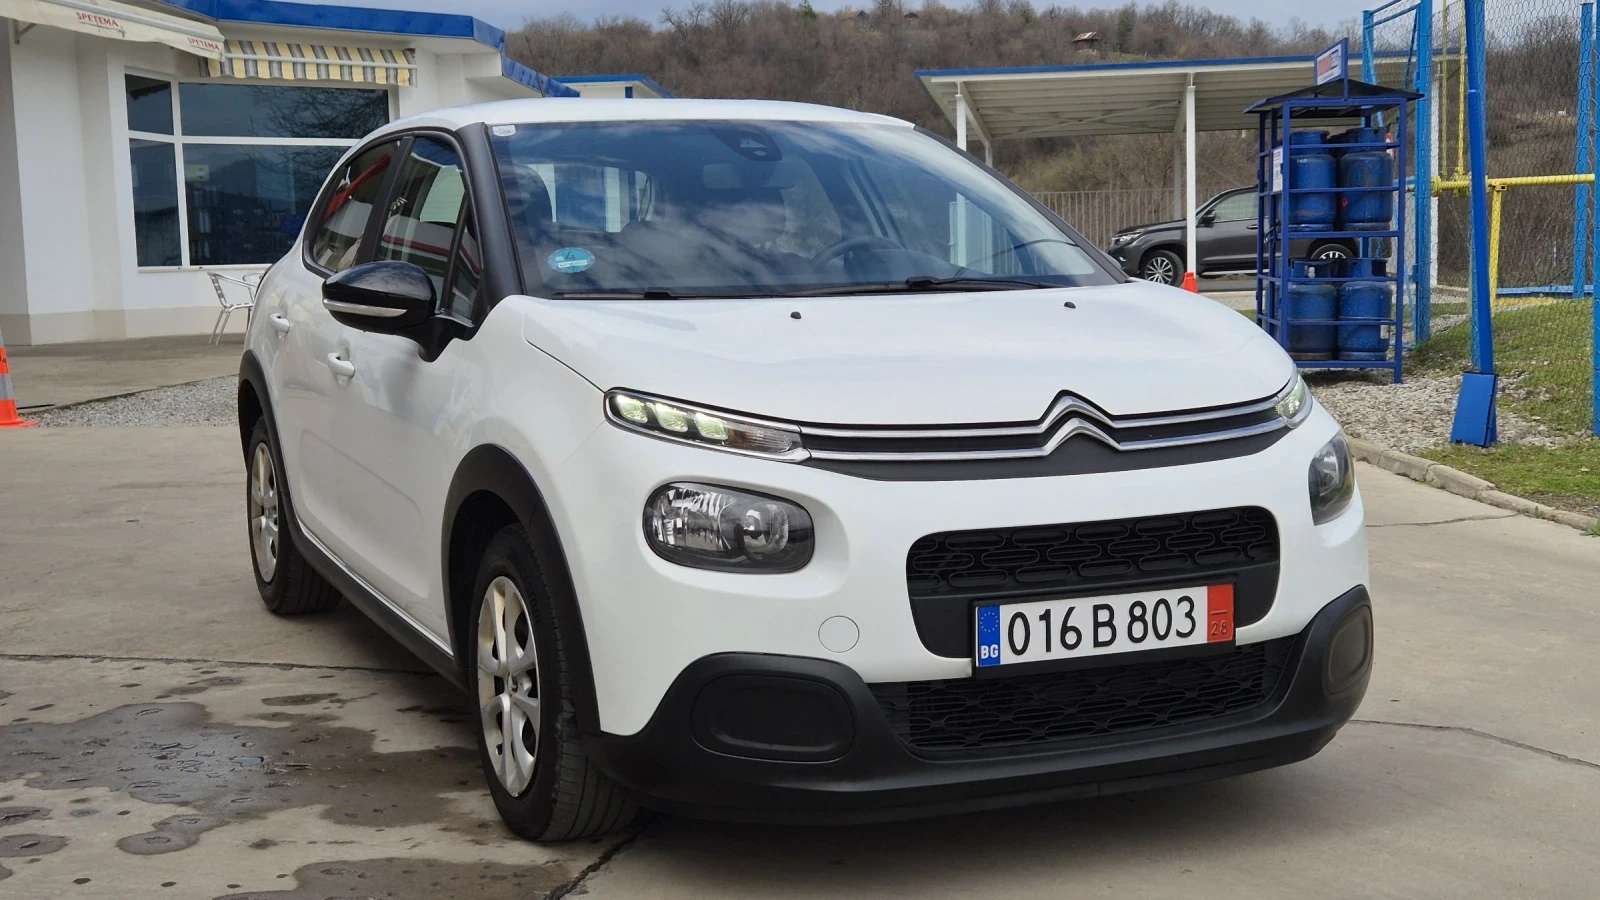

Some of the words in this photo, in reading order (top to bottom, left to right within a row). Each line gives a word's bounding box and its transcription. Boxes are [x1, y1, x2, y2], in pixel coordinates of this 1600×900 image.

[76, 11, 119, 27] SPETEMA
[1211, 620, 1228, 636] 28
[980, 644, 999, 659] BG
